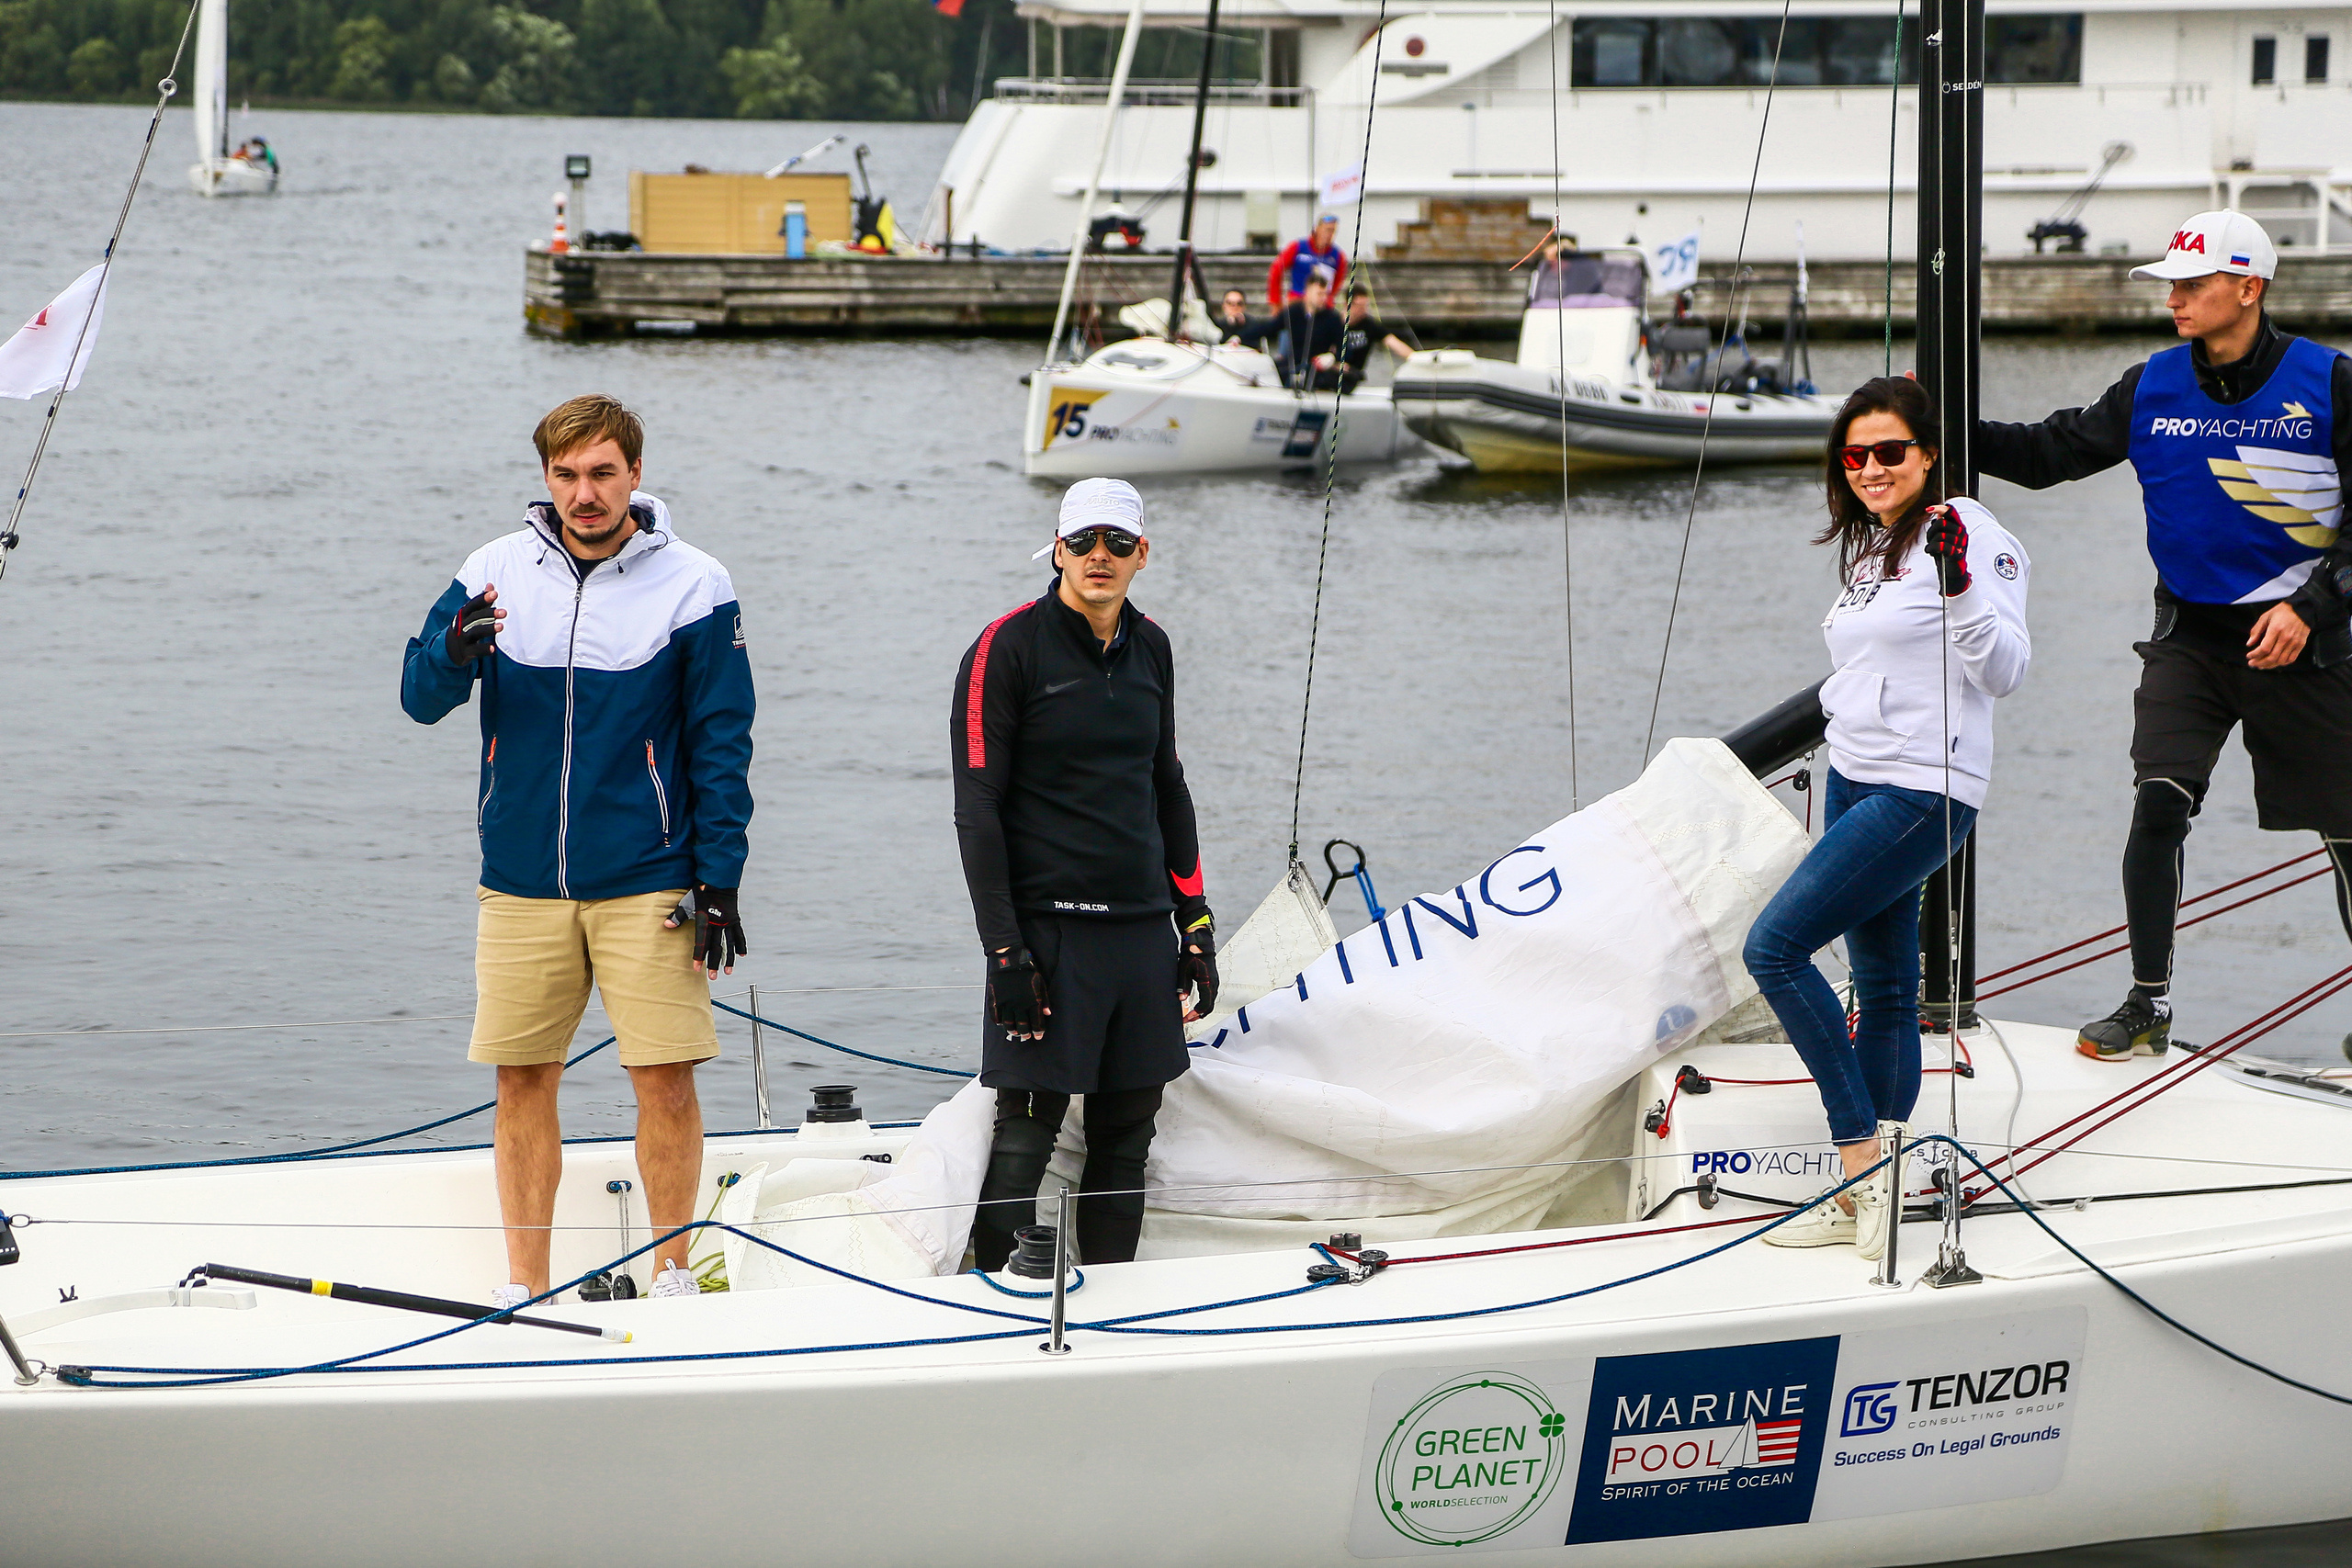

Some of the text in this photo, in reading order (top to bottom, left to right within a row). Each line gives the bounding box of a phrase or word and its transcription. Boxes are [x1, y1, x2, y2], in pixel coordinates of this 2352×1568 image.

[1052, 402, 1090, 437] 15
[2150, 417, 2312, 440] PROYACHTING
[707, 908, 722, 918] Gill
[1054, 901, 1110, 912] TASK-ON.COM
[1692, 1151, 1845, 1175] PROYACHTI
[1905, 1359, 2071, 1413] TENZOR
[1612, 1383, 1808, 1431] MARINE
[1907, 1401, 2066, 1429] CONSULTING GROUP
[1415, 1425, 1527, 1457] GREEN
[1834, 1425, 2062, 1467] Success On Legal Grounds
[1610, 1439, 1722, 1475] POOL
[1411, 1458, 1542, 1492] PLANET
[1601, 1472, 1794, 1501] SPIRIT OF THE OCEAN
[1409, 1495, 1509, 1509] WORLDSELECTION
